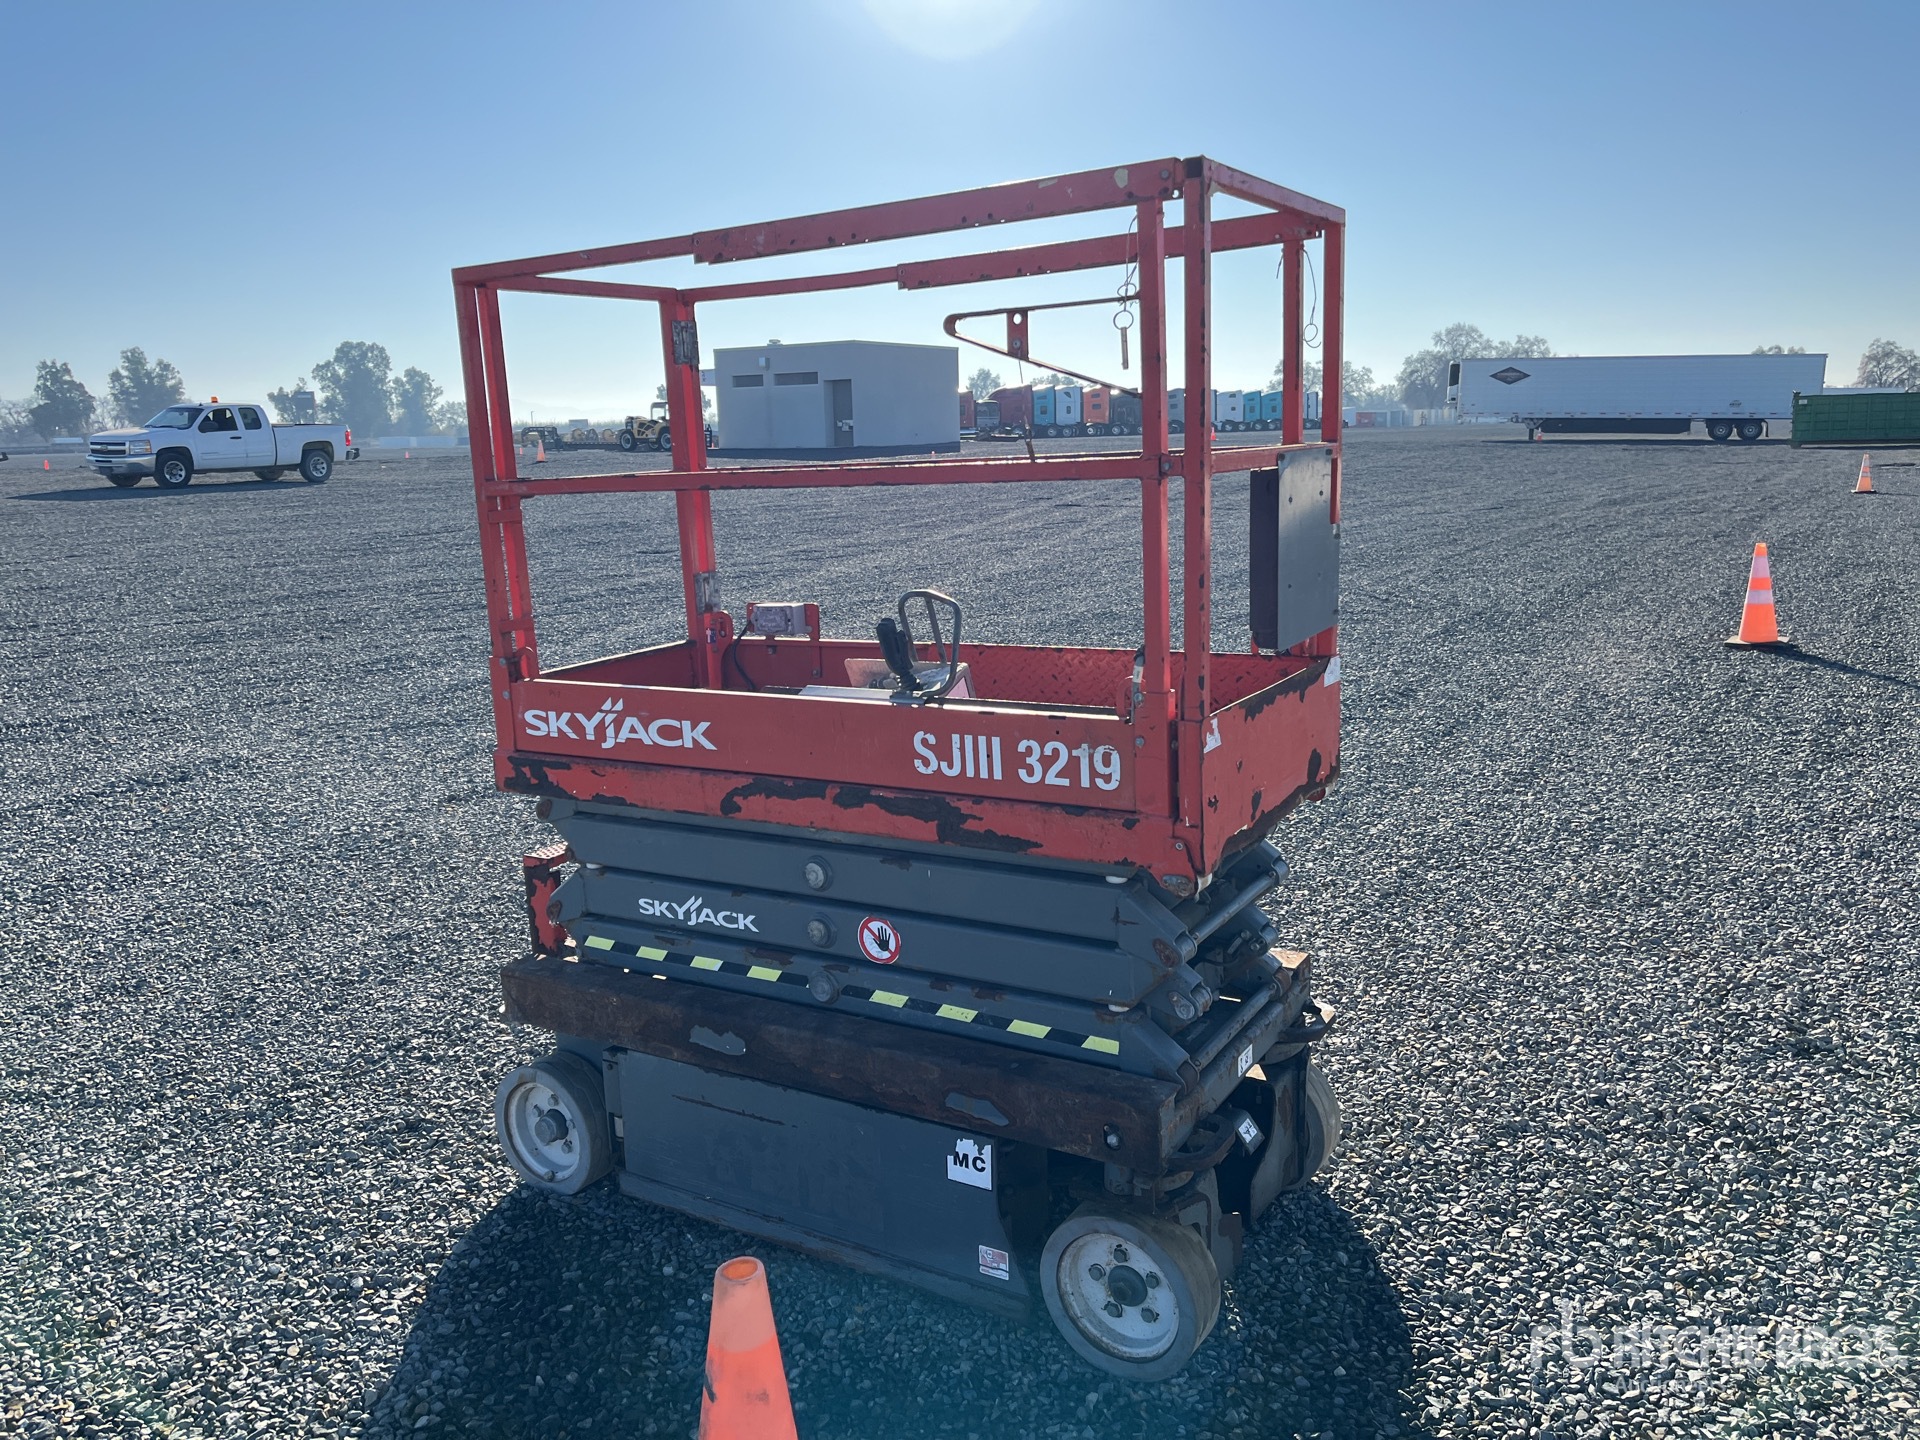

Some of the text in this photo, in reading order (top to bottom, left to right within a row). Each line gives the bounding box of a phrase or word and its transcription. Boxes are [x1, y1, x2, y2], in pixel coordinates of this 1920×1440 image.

[523, 697, 717, 750] SKYJACK
[913, 730, 1122, 791] SJIII 3219
[638, 895, 759, 933] SKYJACK
